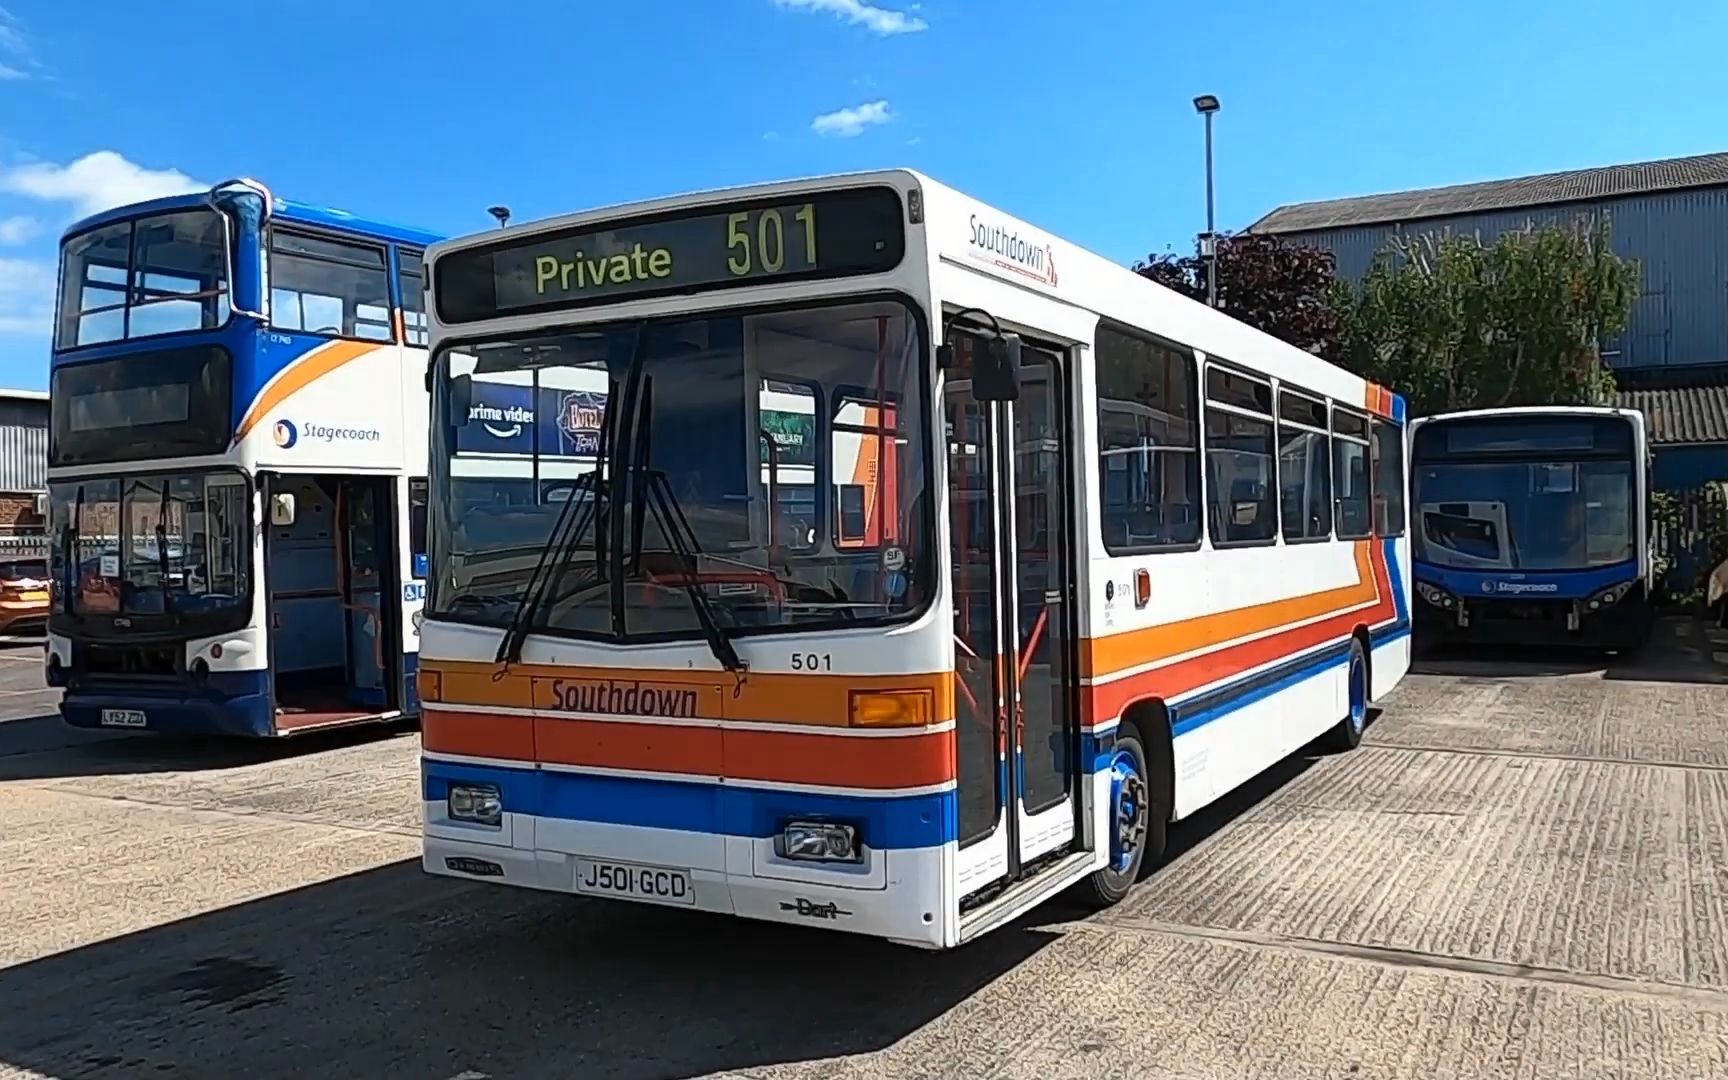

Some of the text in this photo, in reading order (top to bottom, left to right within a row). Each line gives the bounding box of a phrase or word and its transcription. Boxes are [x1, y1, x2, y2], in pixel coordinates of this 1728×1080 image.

[535, 203, 817, 294] Private 501
[969, 213, 1044, 272] Southdown
[302, 421, 380, 443] Stagecoach
[791, 653, 833, 672] 501
[551, 678, 698, 718] Southdown
[585, 863, 687, 898] J501 GCD
